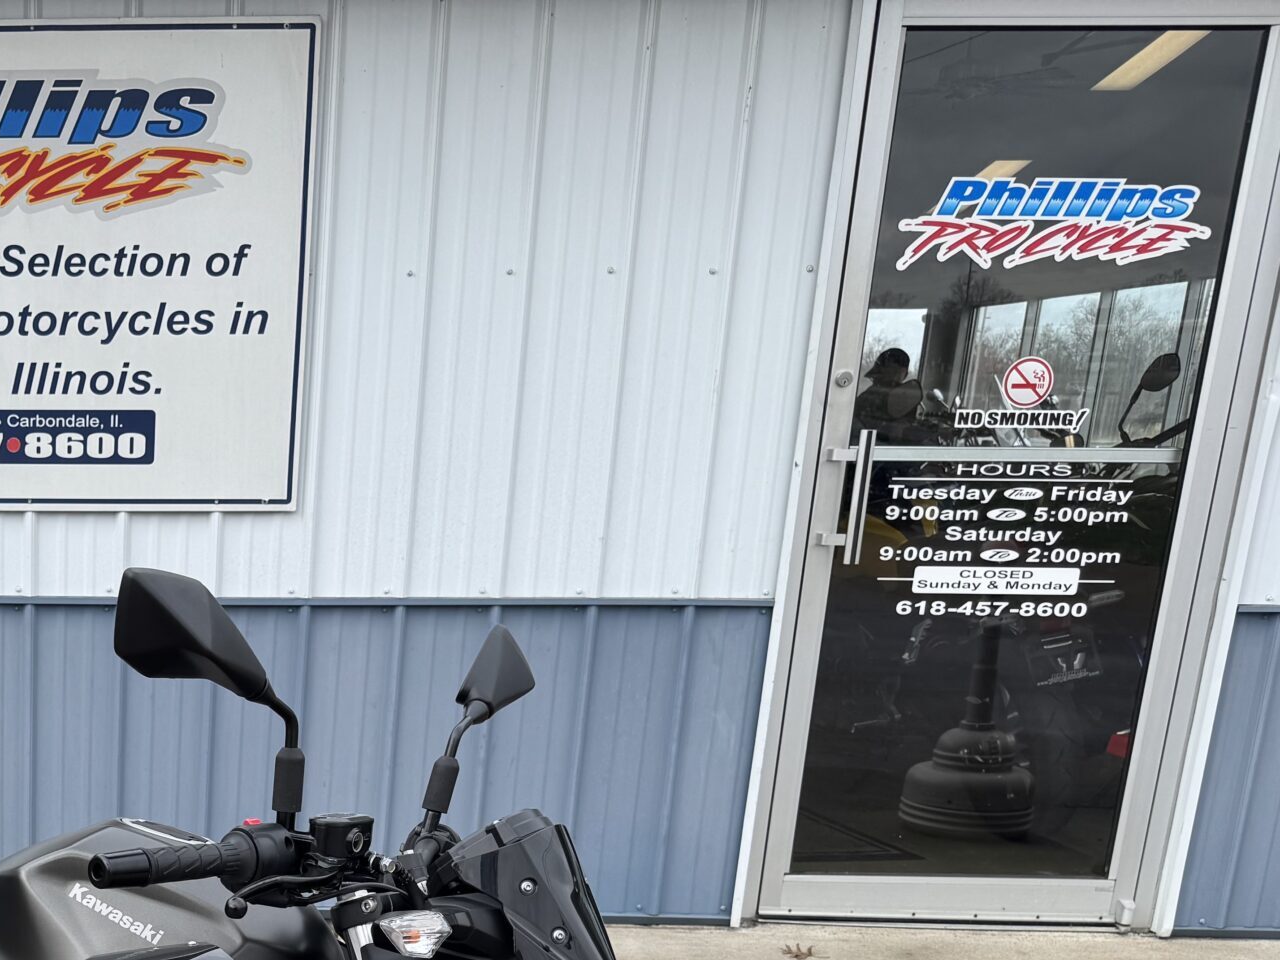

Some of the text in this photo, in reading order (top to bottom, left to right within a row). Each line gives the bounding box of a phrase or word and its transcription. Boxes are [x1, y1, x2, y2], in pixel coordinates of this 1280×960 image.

[935, 178, 1197, 222] Phillips
[904, 219, 1209, 267] PRO CYCLE
[205, 243, 252, 278] of
[228, 301, 270, 335] in
[11, 361, 163, 396] Illinois.
[7, 414, 104, 430] Carbondale,
[956, 410, 1088, 432] NO SMOKING!
[956, 463, 1073, 477] HOURS
[887, 484, 998, 504] Tuesday
[1050, 486, 1134, 506] Friday
[884, 505, 1129, 526] 9:00am To 5:00pm
[944, 525, 1063, 546] Saturday
[878, 546, 1121, 567] 9:00am To 2:00pm
[959, 569, 1034, 580] CLOSED
[916, 579, 1073, 593] Sunday & Monday
[895, 600, 1088, 618] 618-457-8600
[68, 882, 165, 946] Kawasaki
